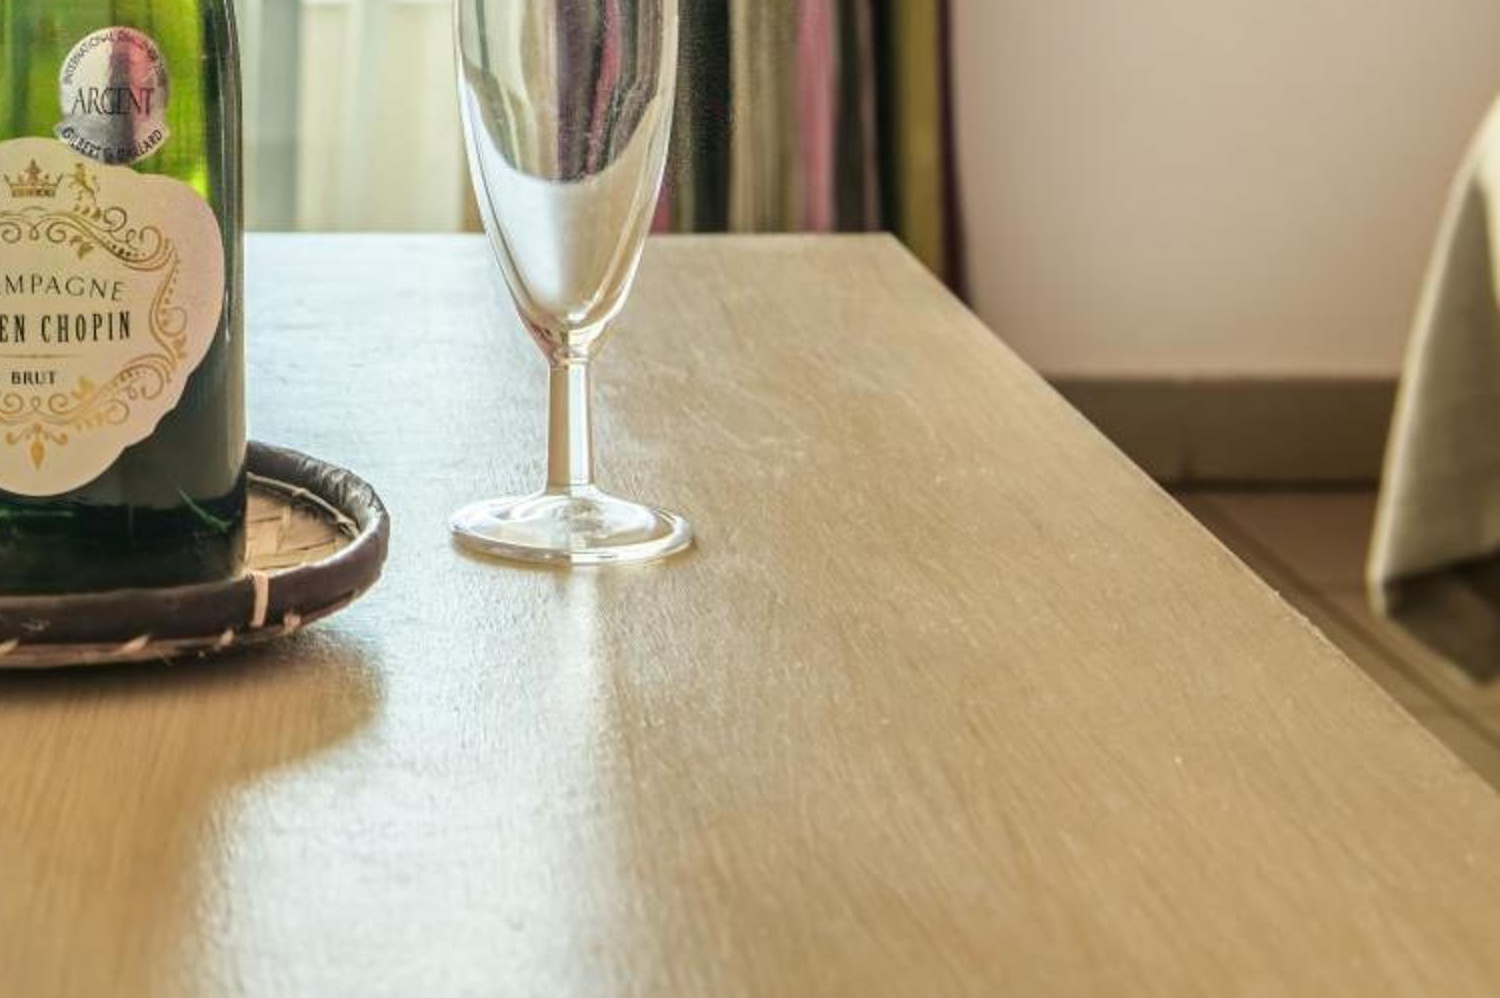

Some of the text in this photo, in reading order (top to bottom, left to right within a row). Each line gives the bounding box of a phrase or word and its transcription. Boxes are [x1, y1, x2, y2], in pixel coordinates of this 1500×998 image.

[71, 86, 155, 115] ARGENT
[41, 310, 132, 343] CHOPIN
[10, 370, 57, 387] BRUT
